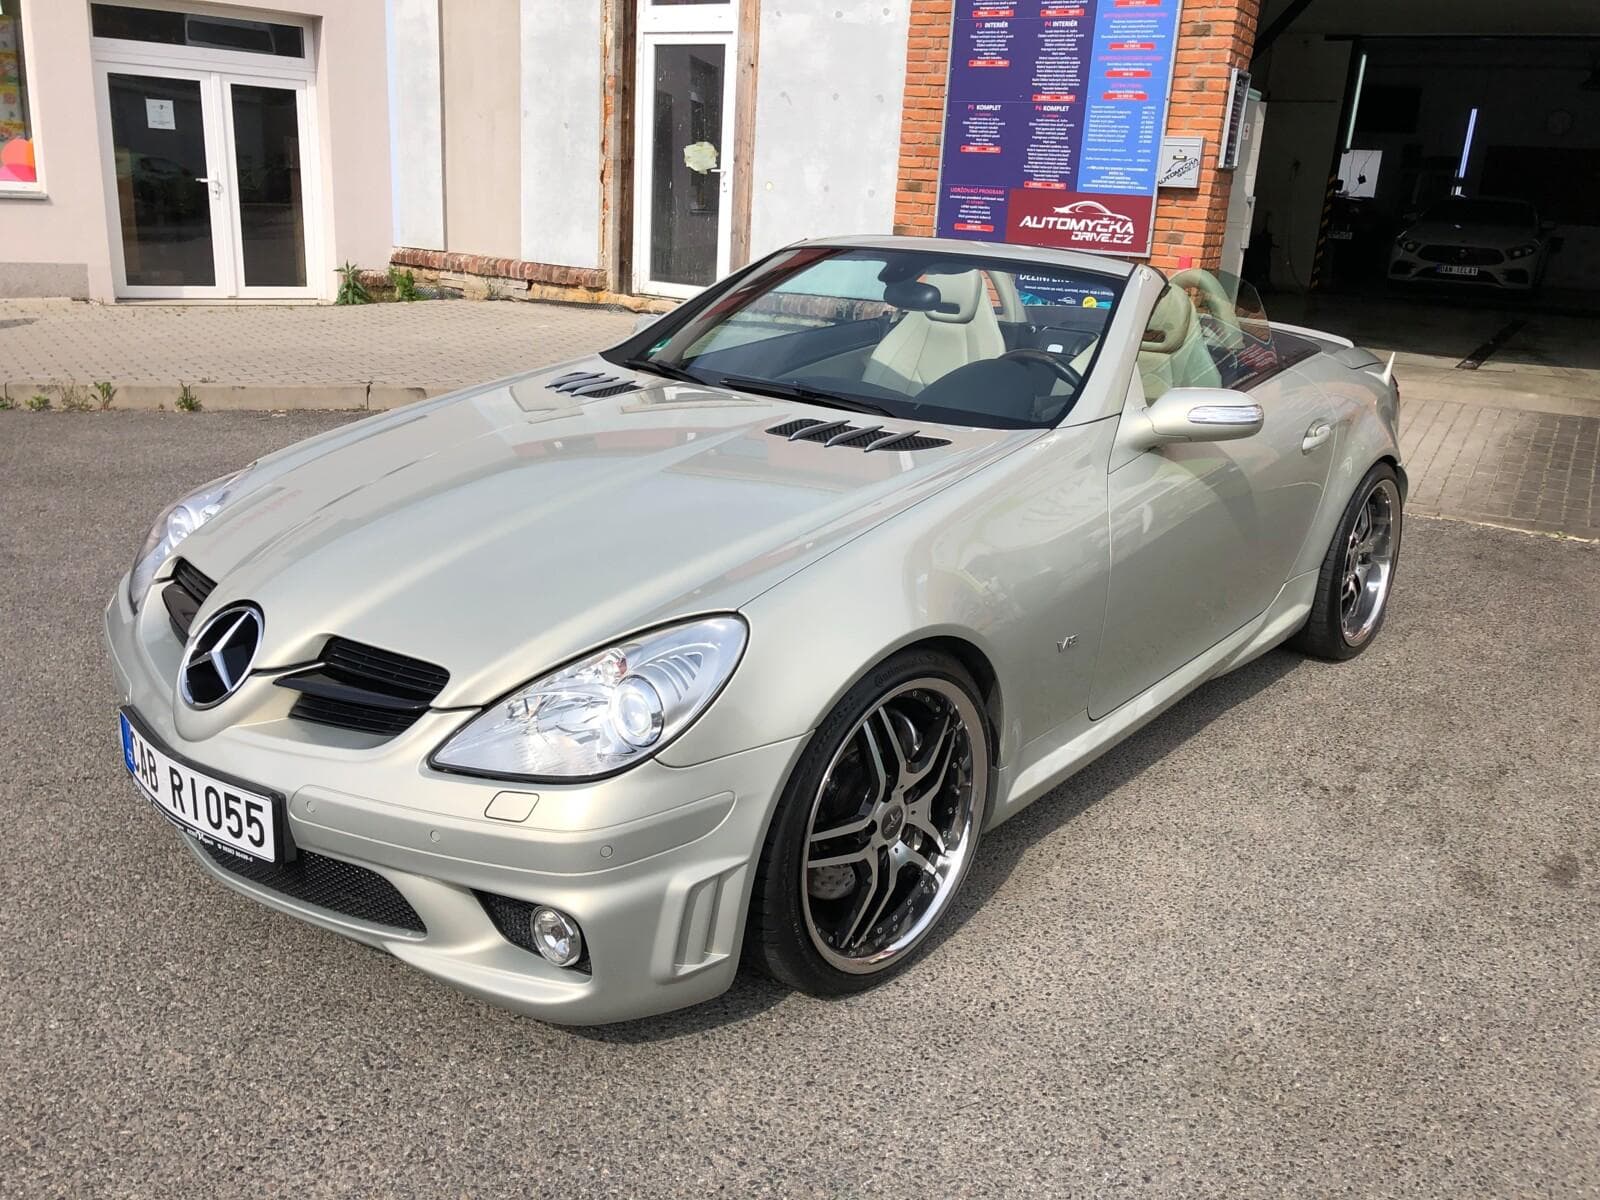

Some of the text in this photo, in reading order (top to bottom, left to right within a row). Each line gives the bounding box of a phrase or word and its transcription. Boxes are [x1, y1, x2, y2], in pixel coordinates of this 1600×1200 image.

[1019, 215, 1135, 234] AUTOMYČKA
[1071, 231, 1134, 245] DRIVE.CZ
[130, 731, 159, 793] CAB
